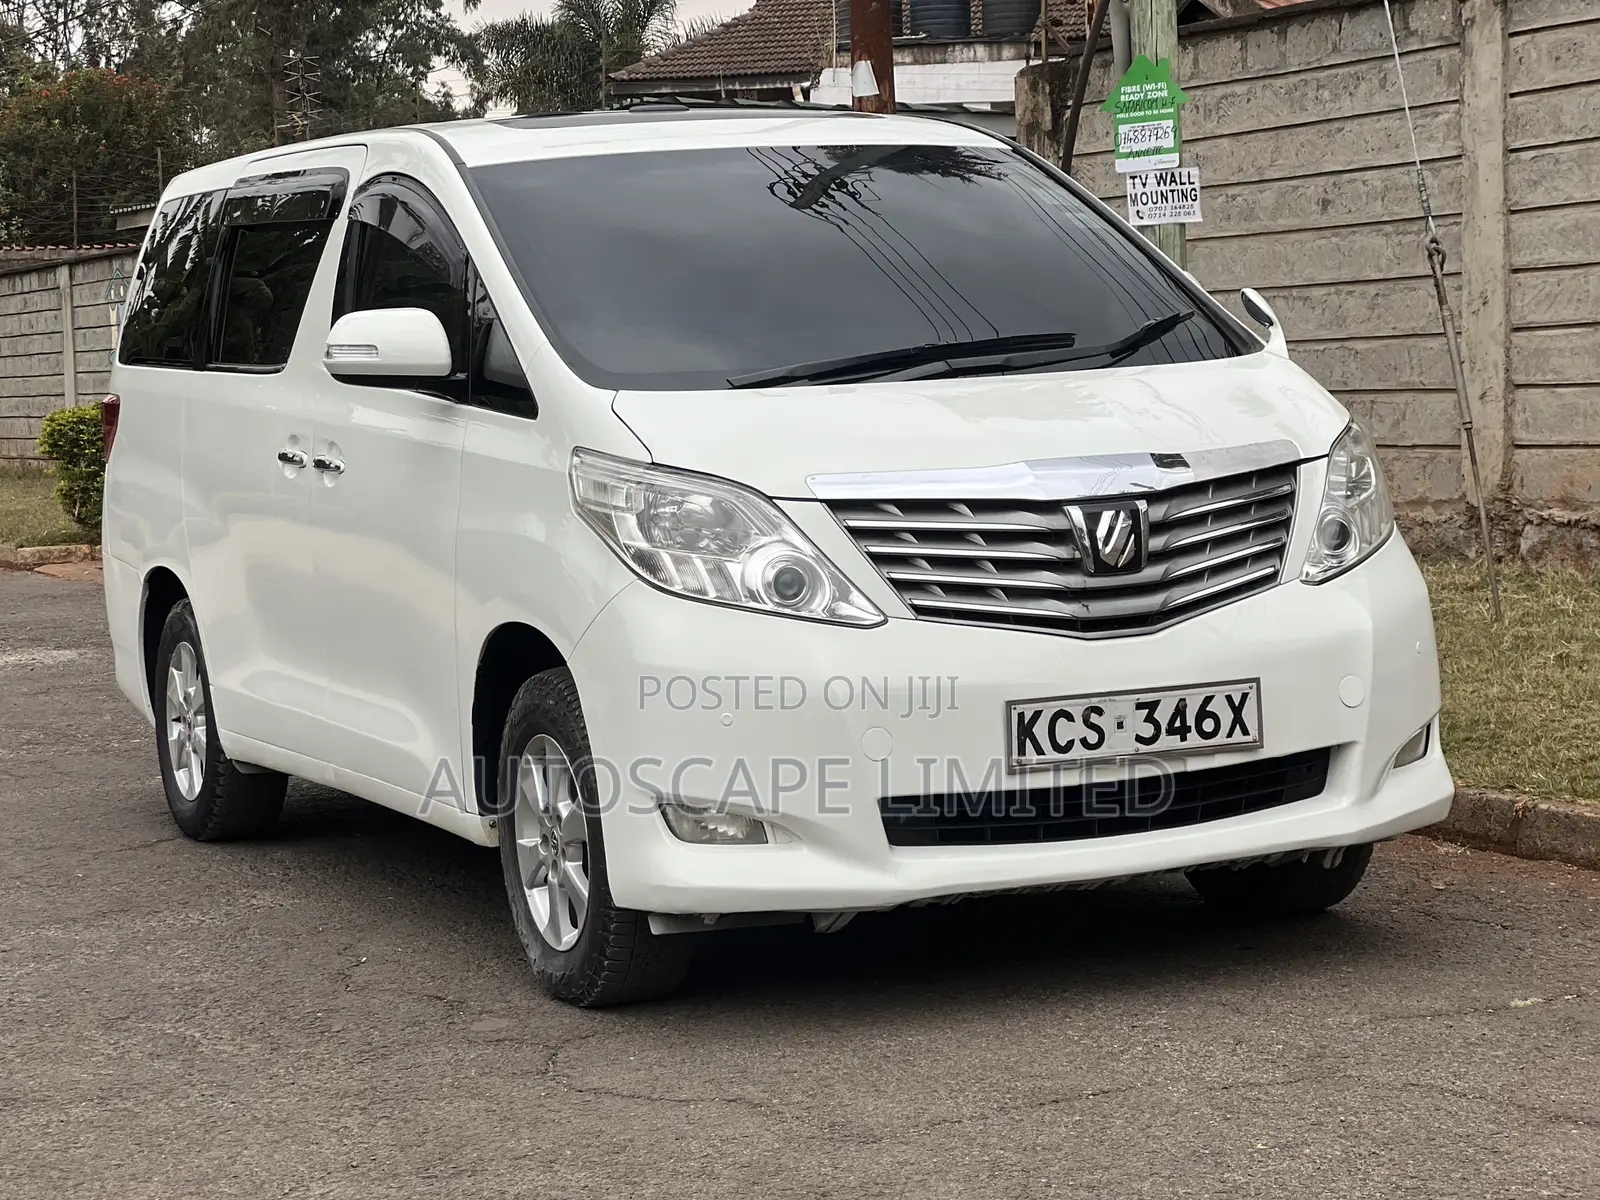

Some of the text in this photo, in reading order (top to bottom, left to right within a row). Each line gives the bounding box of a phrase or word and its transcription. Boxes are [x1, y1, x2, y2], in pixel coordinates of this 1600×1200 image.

[1121, 82, 1167, 93] FIBRE (WI-FI)
[1121, 90, 1168, 101] READY ZONE
[1129, 171, 1195, 189] TV WALL
[1130, 188, 1198, 207] MOUNTING
[1017, 692, 1251, 757] KCS 346X
